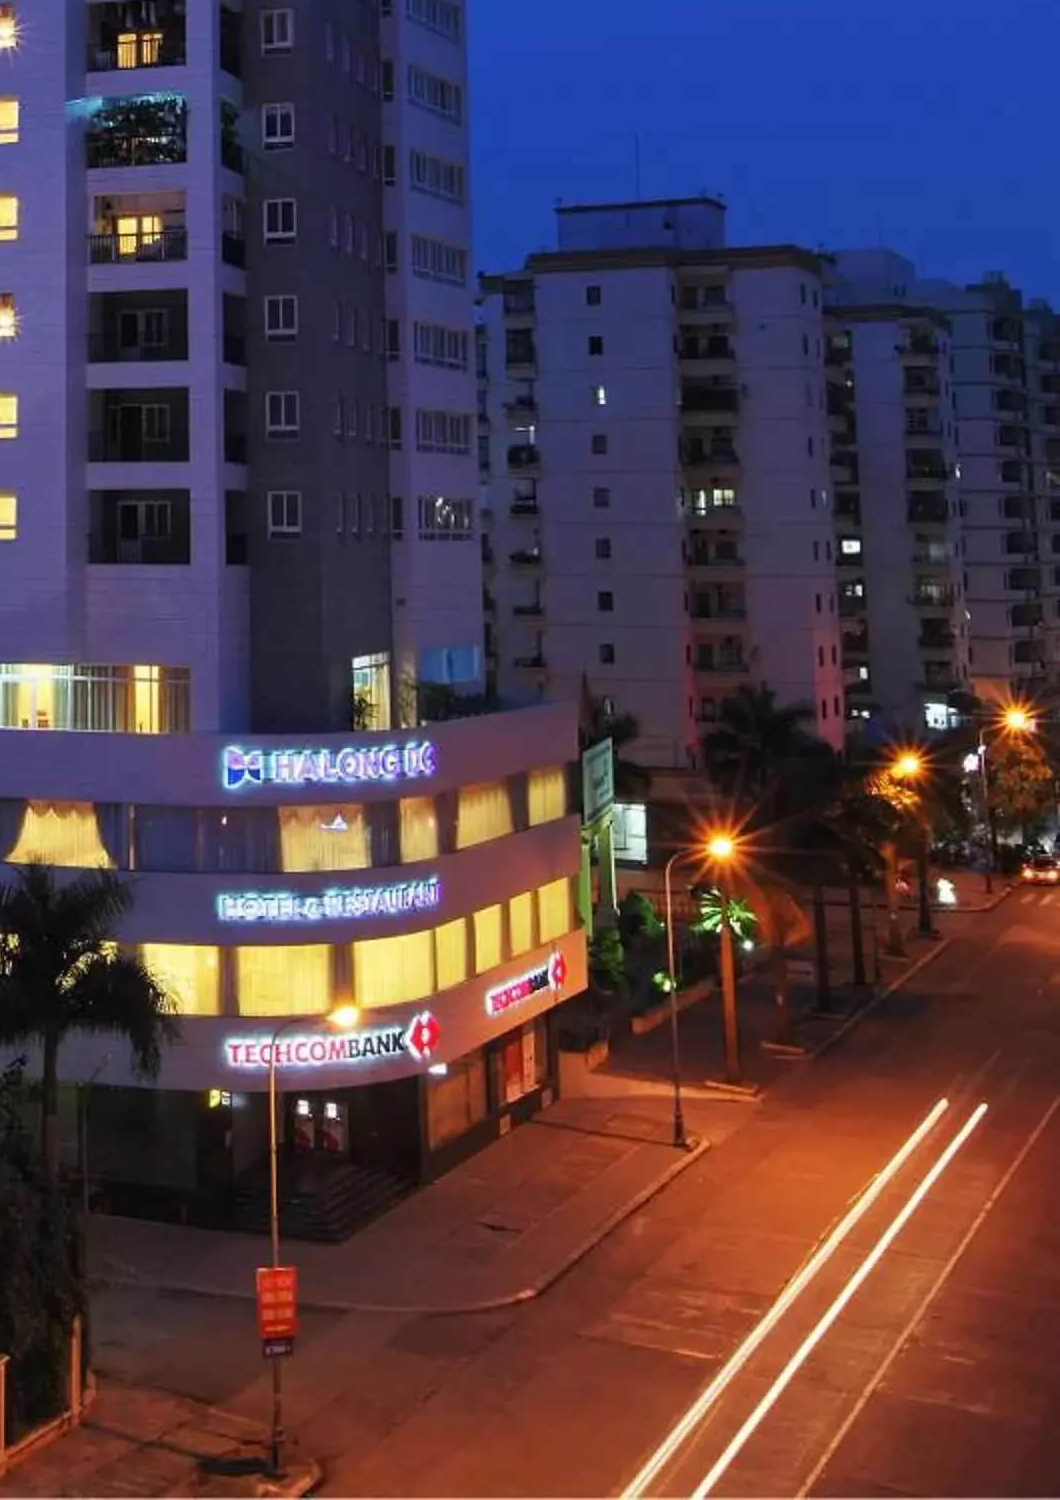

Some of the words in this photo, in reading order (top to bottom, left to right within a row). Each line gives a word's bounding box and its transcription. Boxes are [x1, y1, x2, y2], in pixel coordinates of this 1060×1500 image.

[273, 747, 398, 782] HALONG
[219, 893, 299, 921] HOTEL
[228, 1031, 405, 1064] TECHCOMBANK
